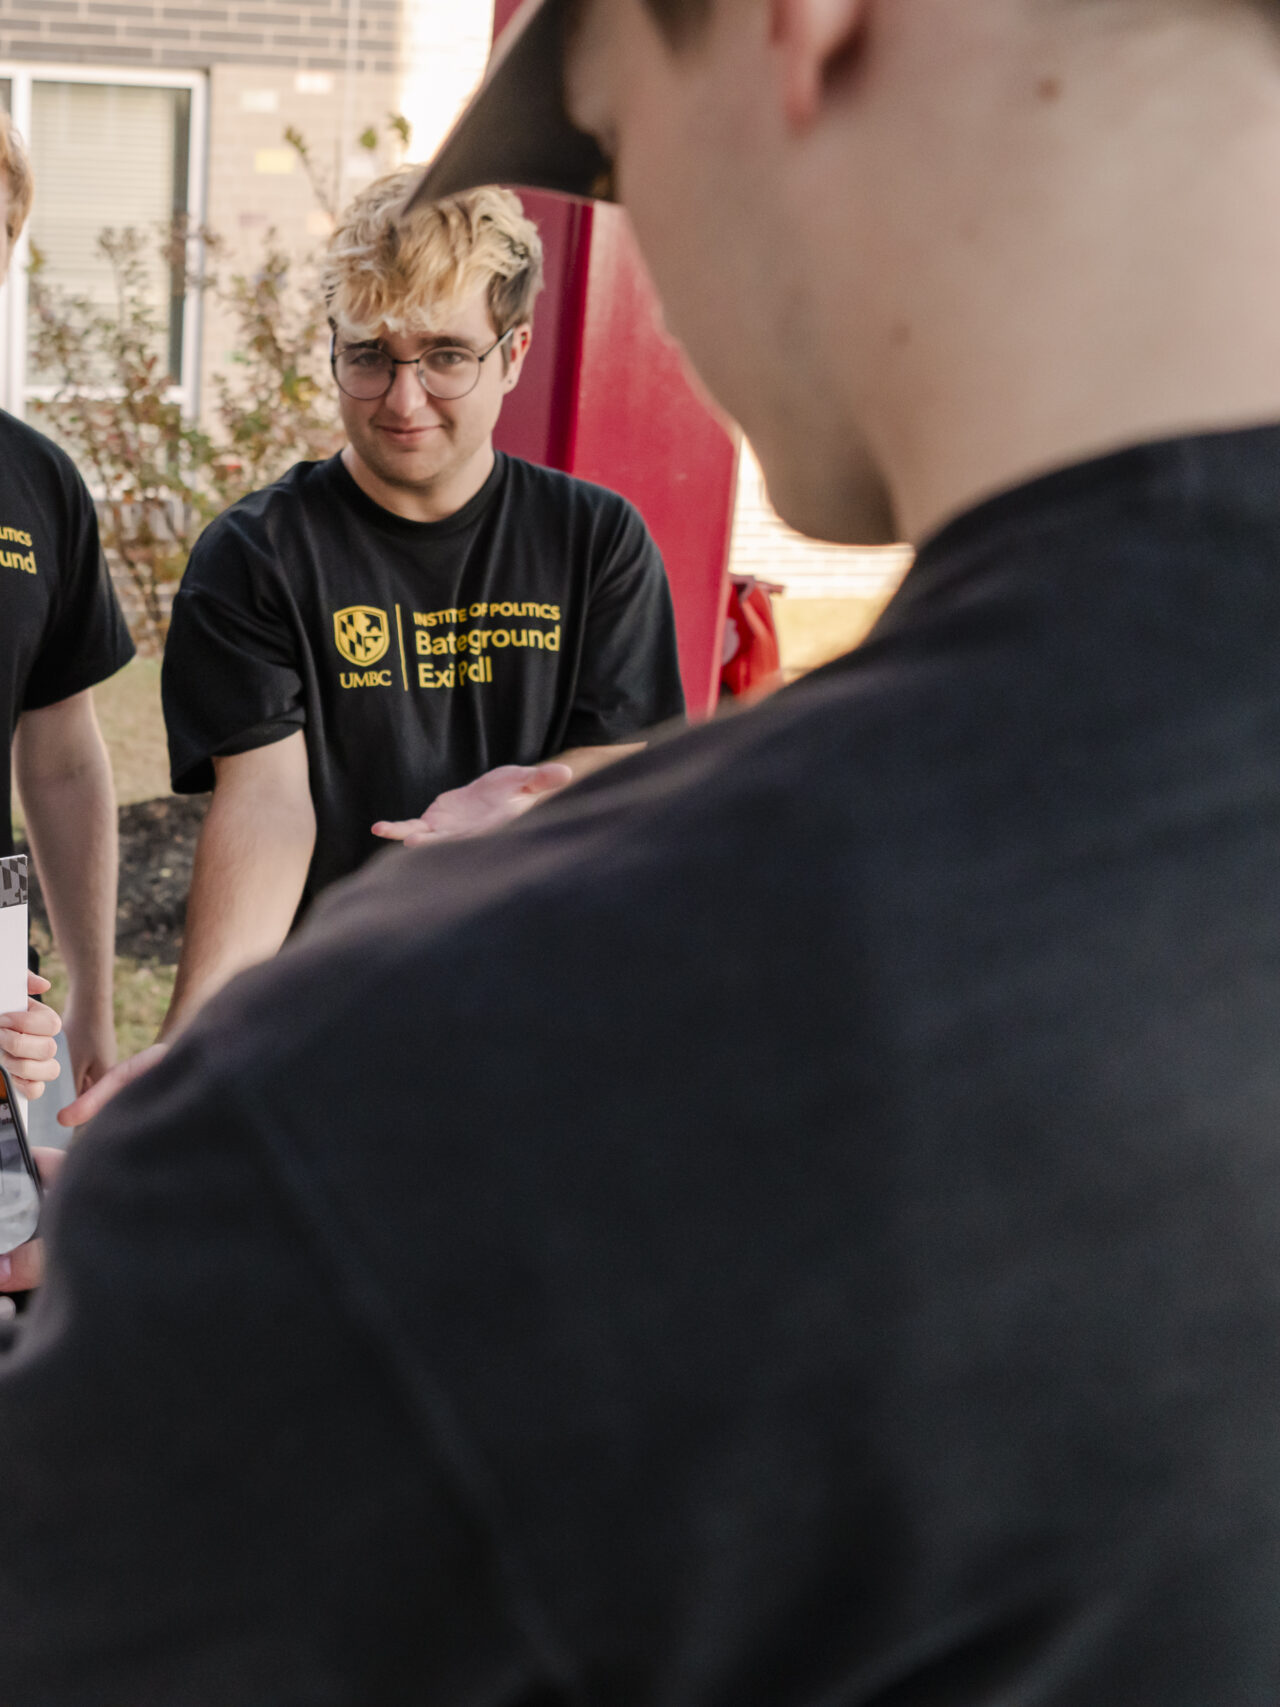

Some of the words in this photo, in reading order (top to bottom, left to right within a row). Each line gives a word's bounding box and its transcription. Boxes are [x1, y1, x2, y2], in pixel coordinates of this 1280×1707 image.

[469, 602, 488, 617] OF
[490, 602, 561, 620] POLITICS
[339, 670, 392, 689] UMBC
[418, 662, 455, 688] Exi
